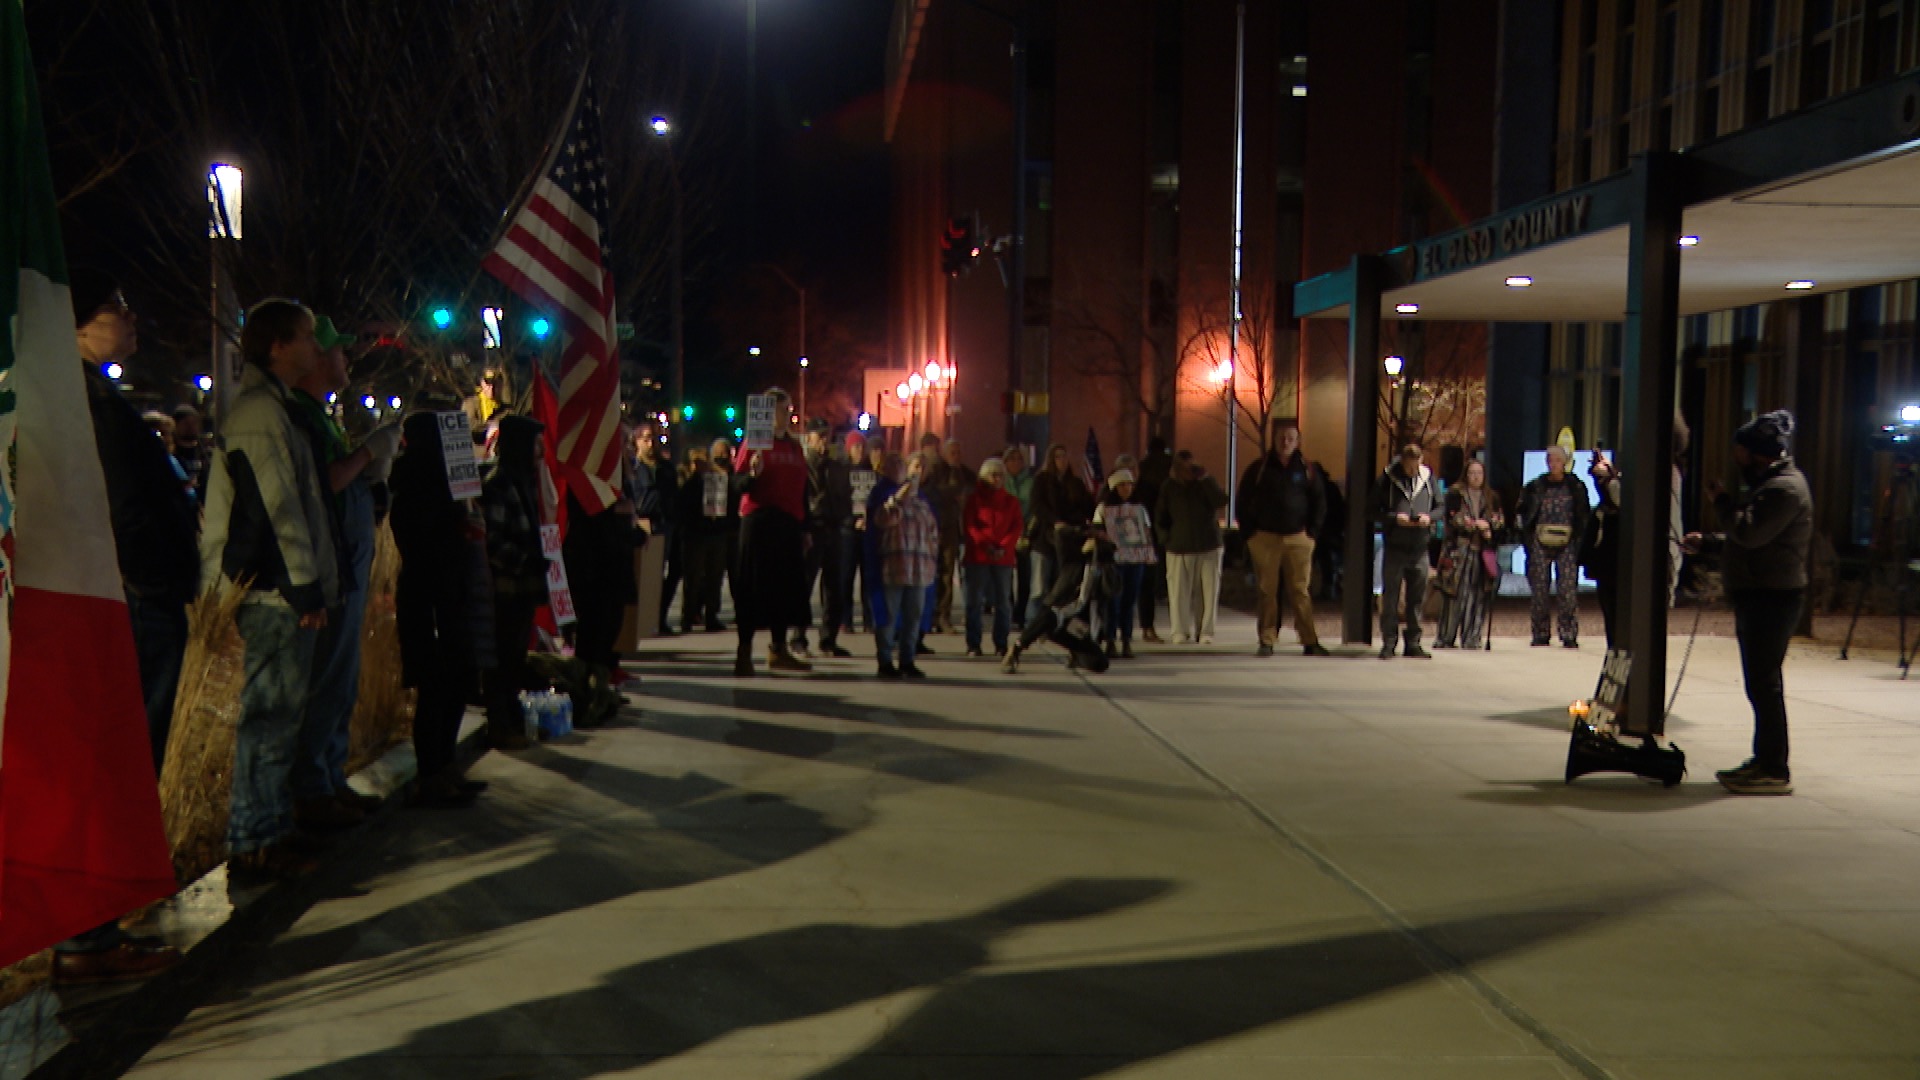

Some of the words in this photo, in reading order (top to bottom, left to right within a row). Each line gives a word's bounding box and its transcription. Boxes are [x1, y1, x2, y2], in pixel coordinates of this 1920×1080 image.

[1422, 243, 1443, 275] EL
[1448, 225, 1493, 266] PASO
[1502, 194, 1589, 252] COUNTY
[439, 414, 469, 430] ICE
